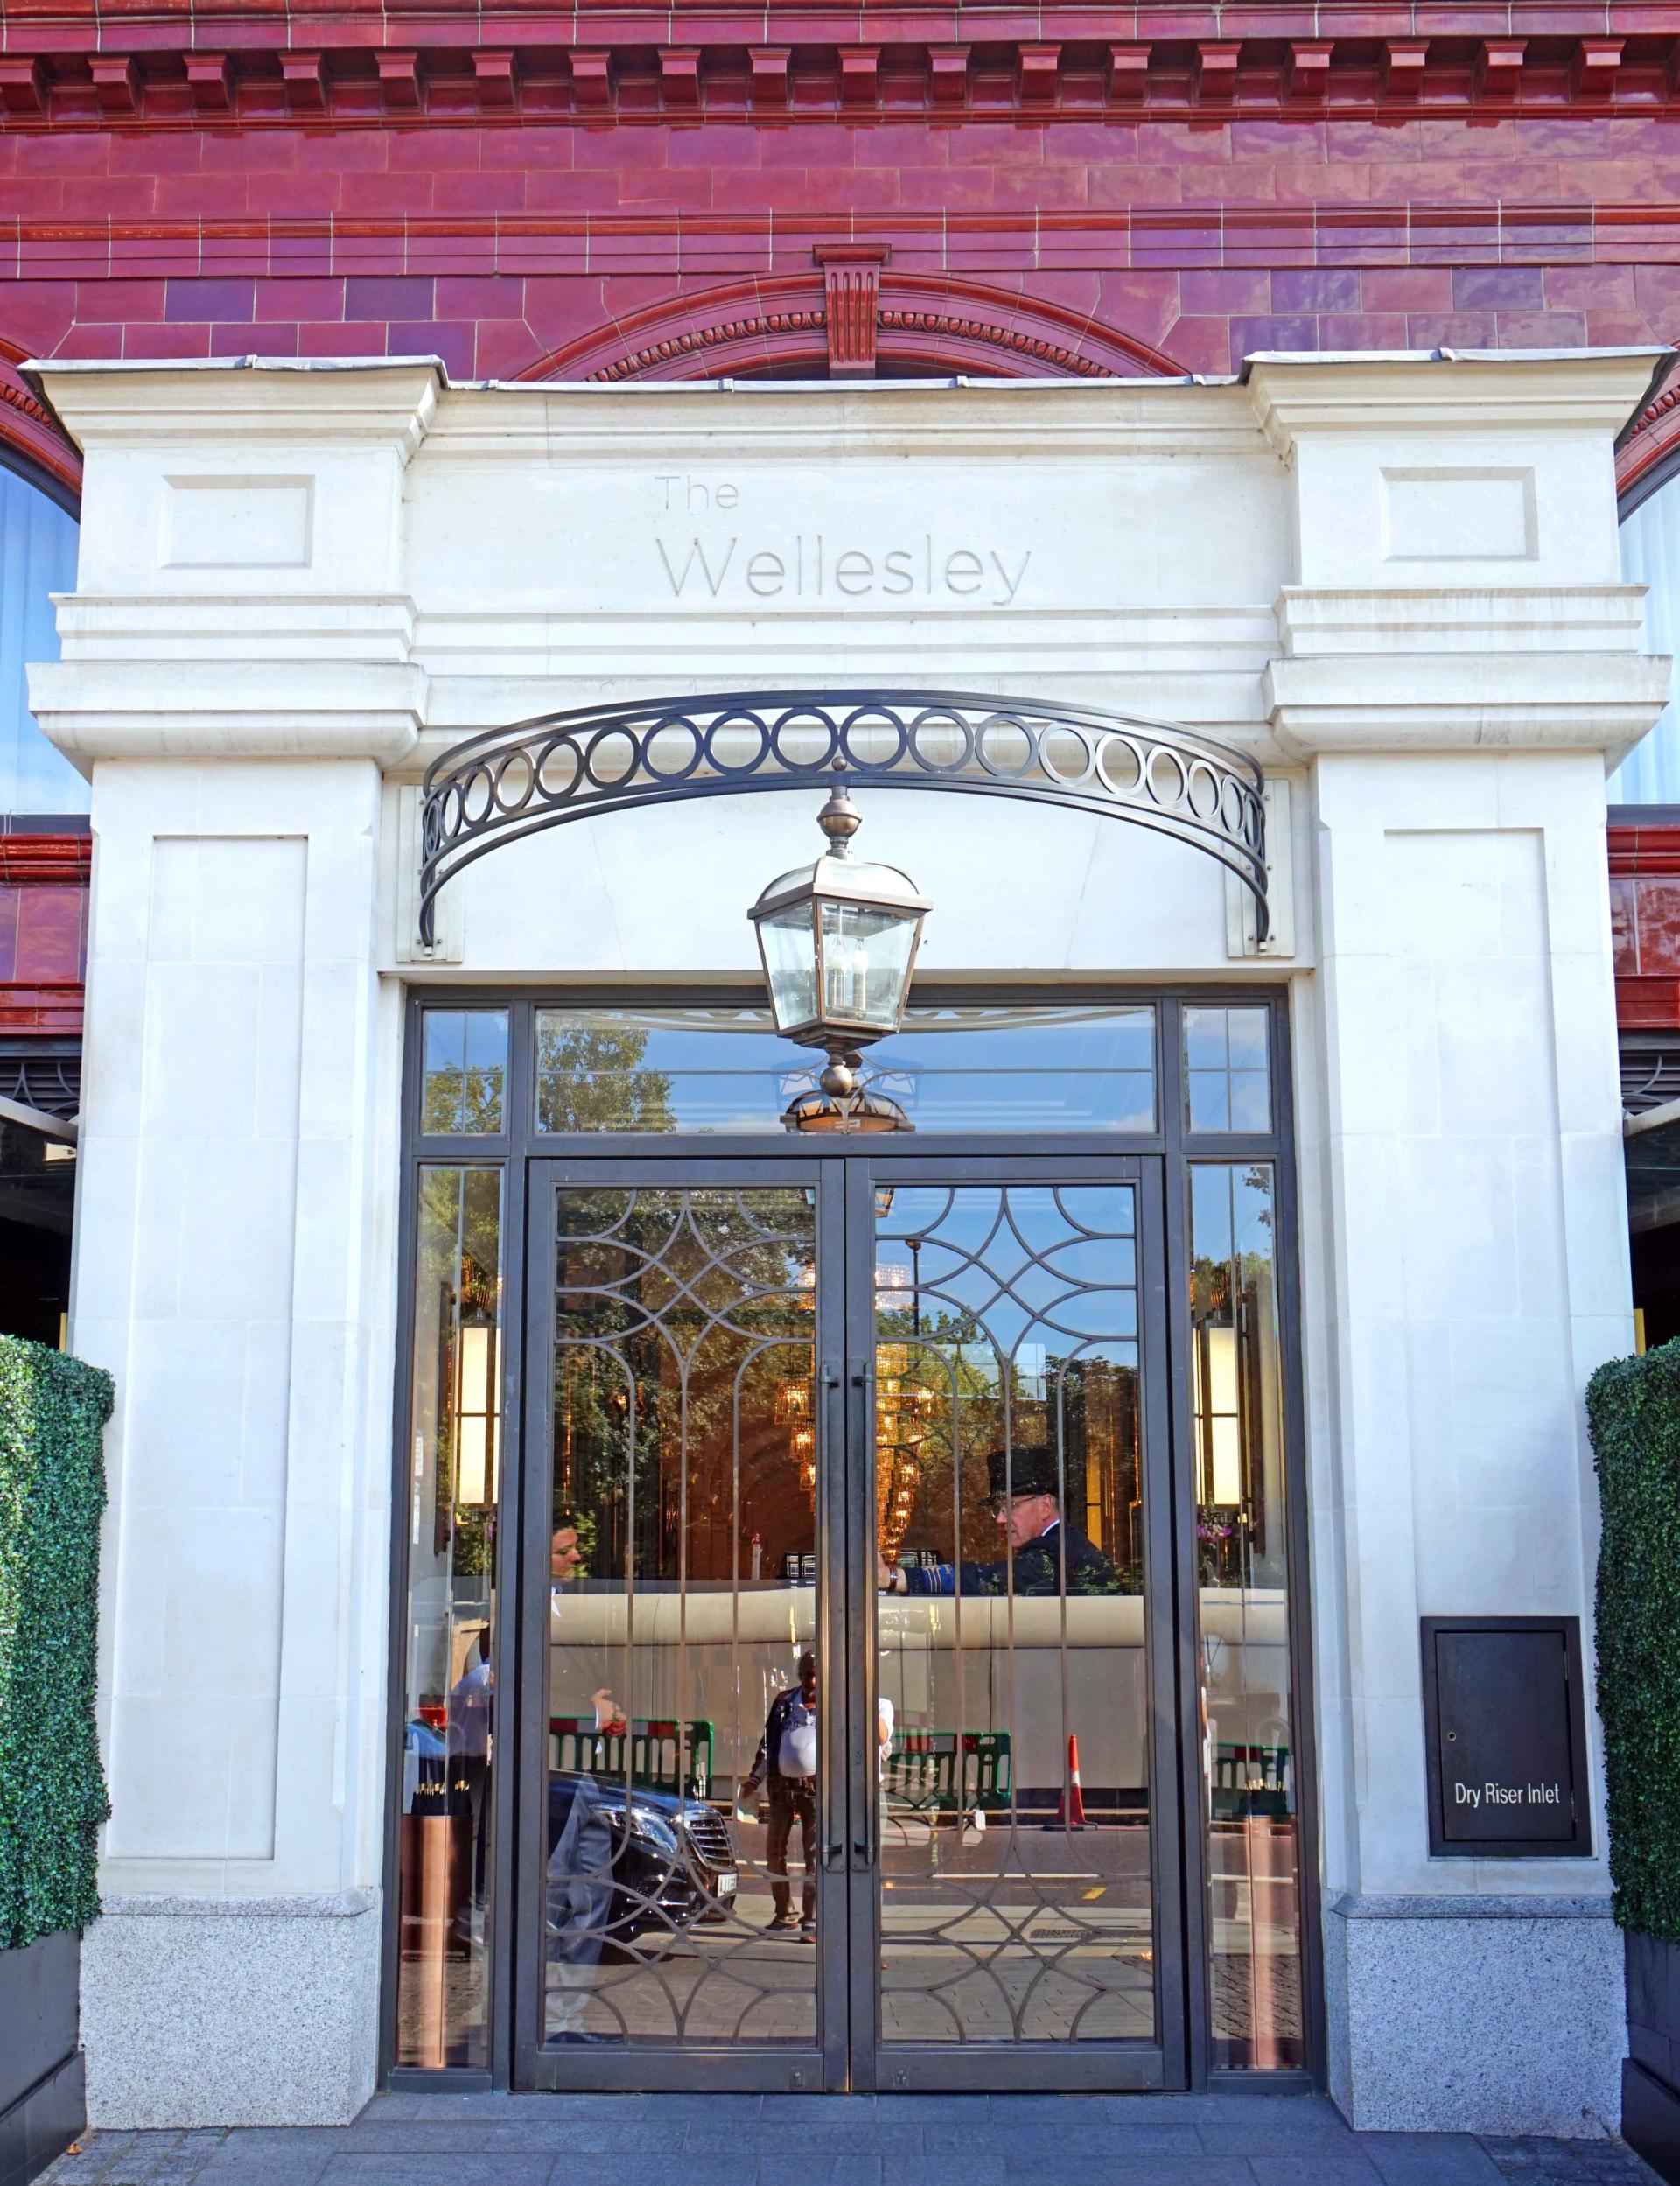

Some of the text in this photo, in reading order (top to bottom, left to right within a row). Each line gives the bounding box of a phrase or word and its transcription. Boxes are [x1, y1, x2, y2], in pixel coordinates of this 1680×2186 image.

[654, 474, 739, 510] The
[655, 533, 1032, 606] Wellesley
[1455, 1783, 1560, 1808] Dry Riser Inlet
